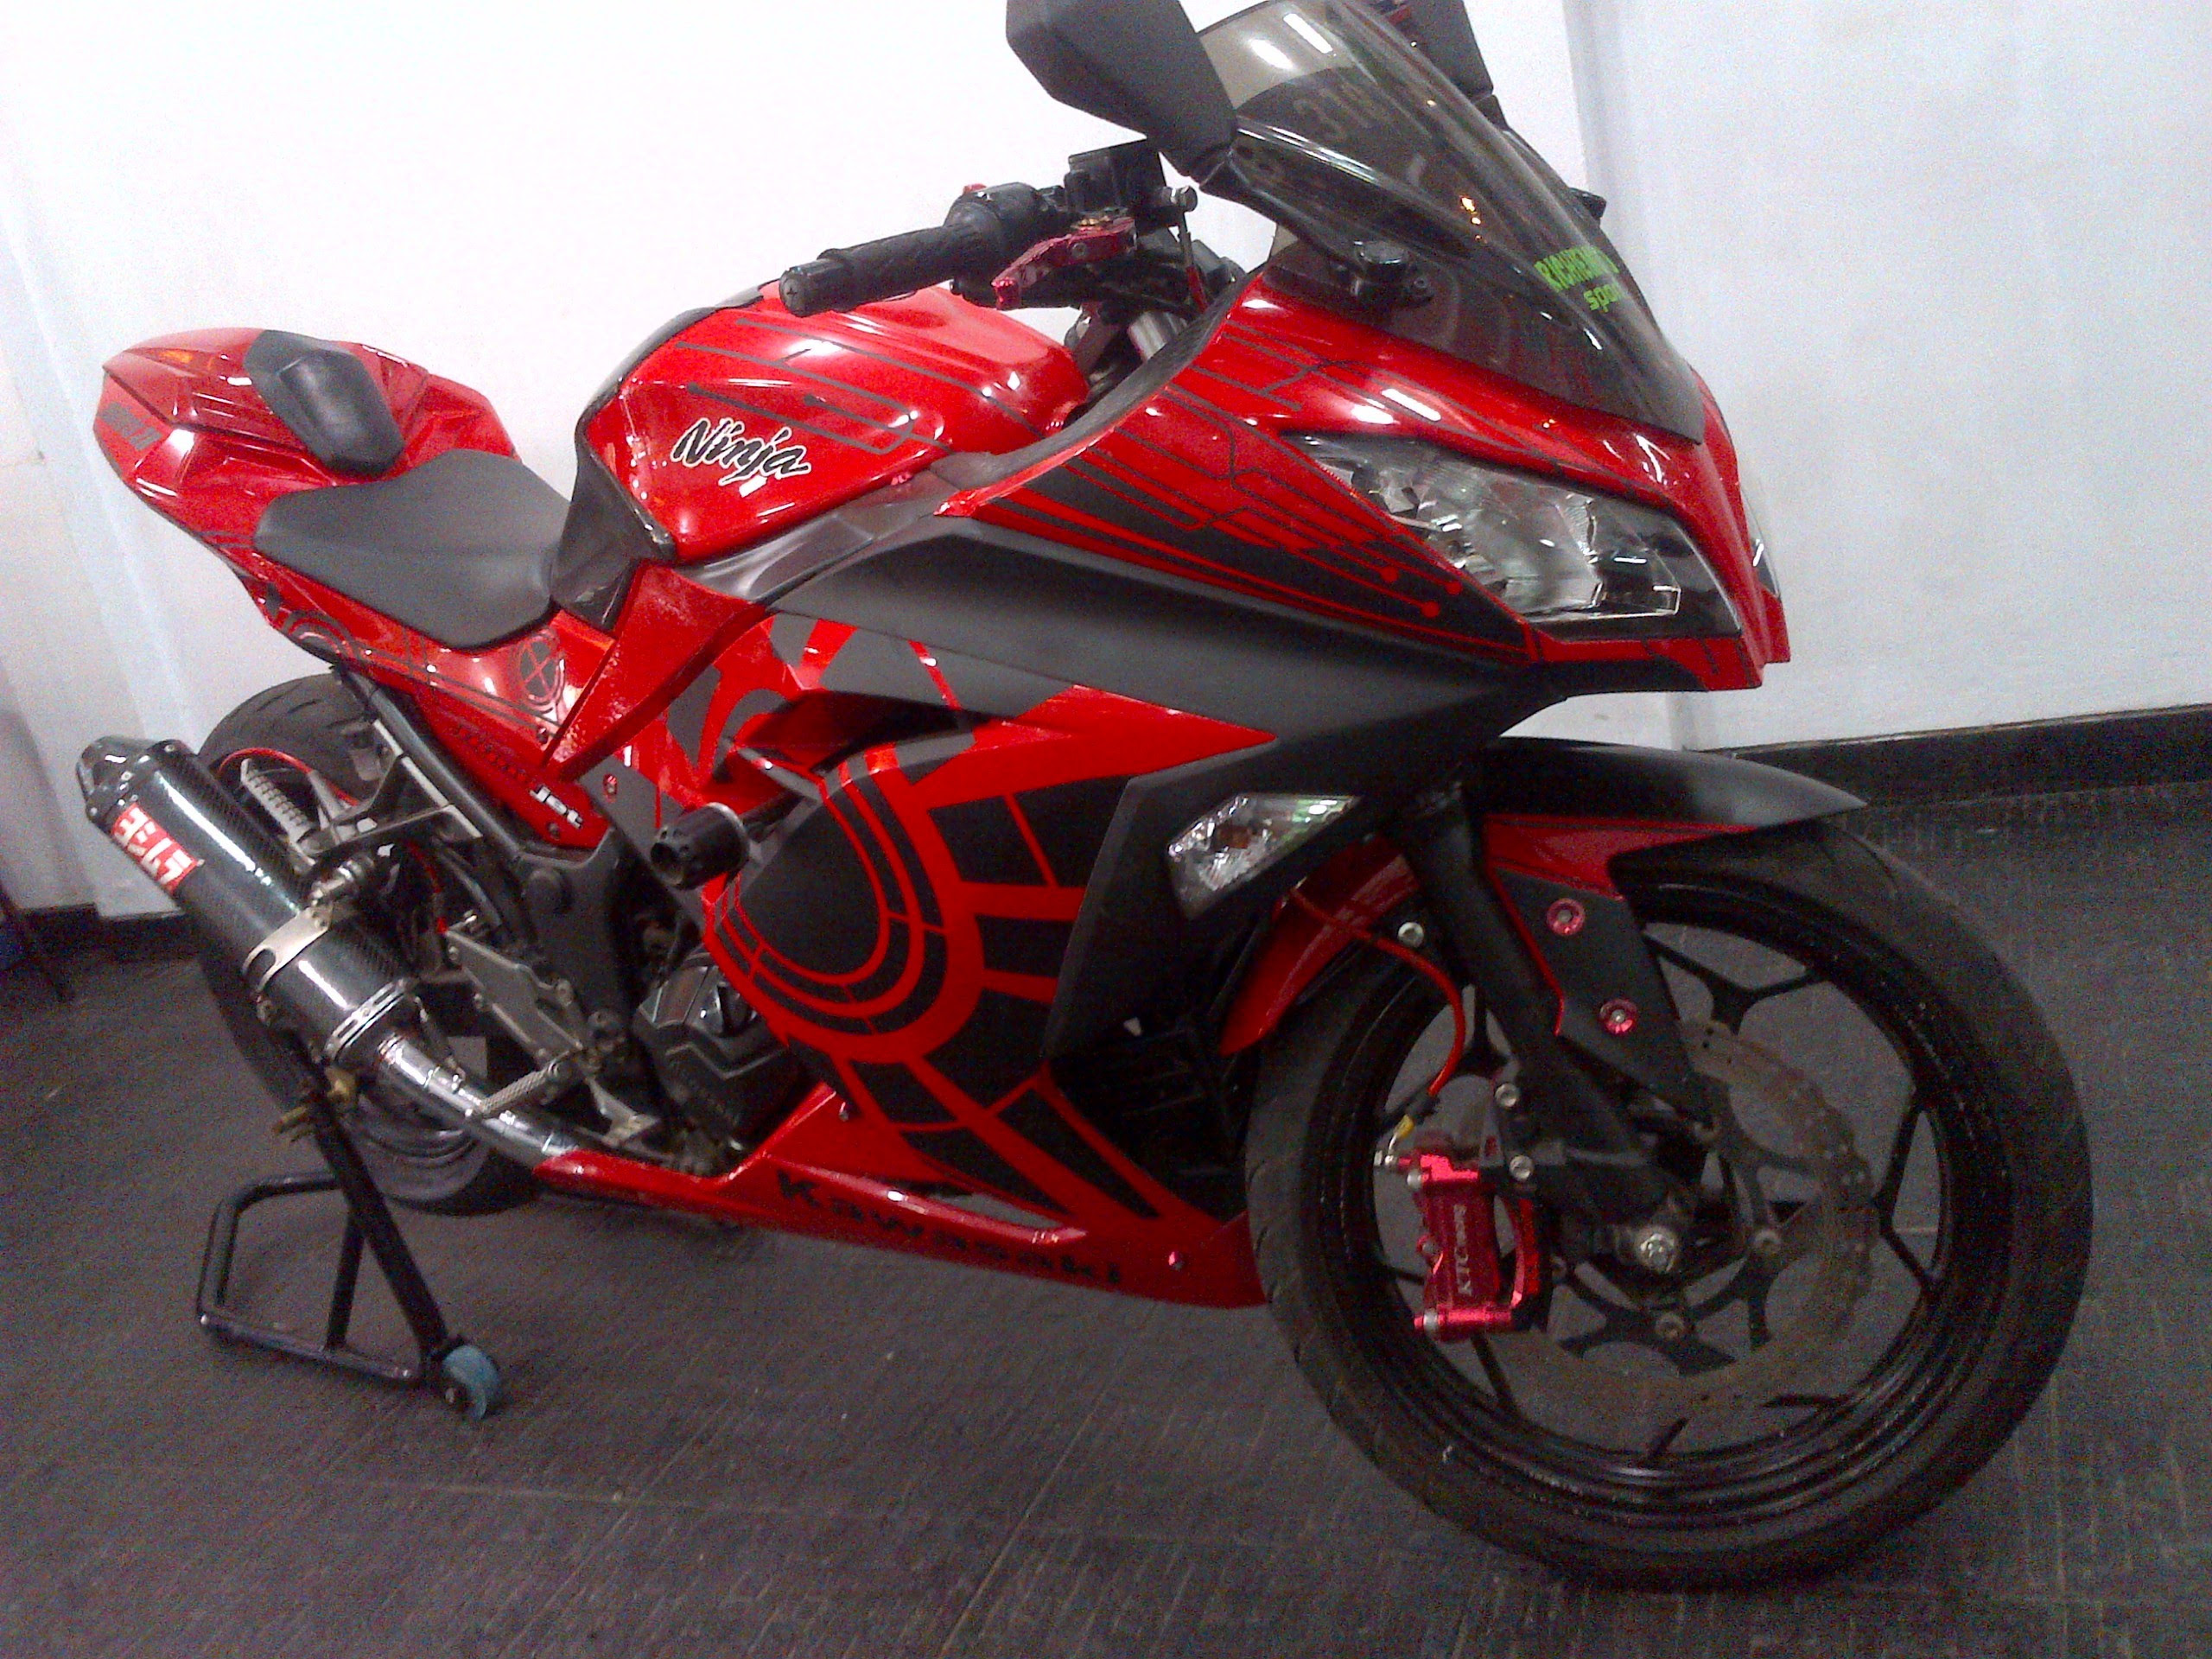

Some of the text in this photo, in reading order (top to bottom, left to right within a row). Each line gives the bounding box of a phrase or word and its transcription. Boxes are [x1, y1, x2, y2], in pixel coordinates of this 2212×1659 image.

[670, 417, 812, 486] Ninja
[113, 805, 194, 887] ヨシムラ
